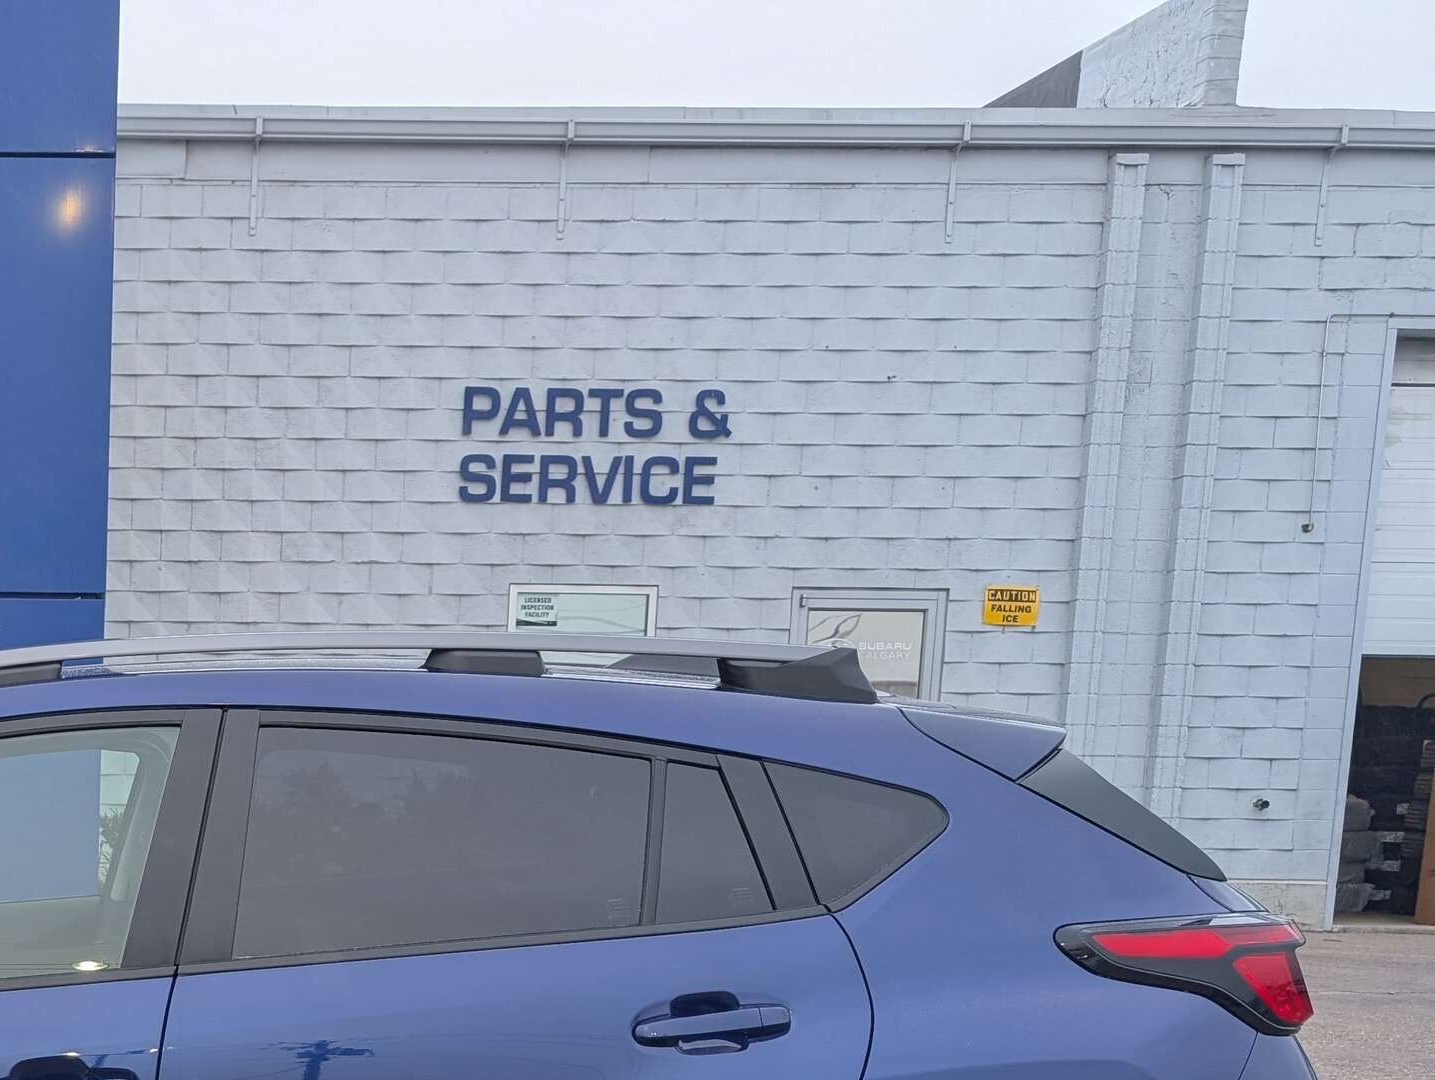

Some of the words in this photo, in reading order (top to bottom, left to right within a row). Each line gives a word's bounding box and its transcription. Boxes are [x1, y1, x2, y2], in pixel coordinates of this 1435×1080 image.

[462, 386, 664, 437] PARTS
[689, 389, 732, 438] &
[459, 454, 718, 505] SERVICE
[989, 590, 1036, 601] CAUTION
[991, 604, 1032, 613] FALLING
[1002, 615, 1018, 623] ICE
[858, 642, 911, 650] SUBARU
